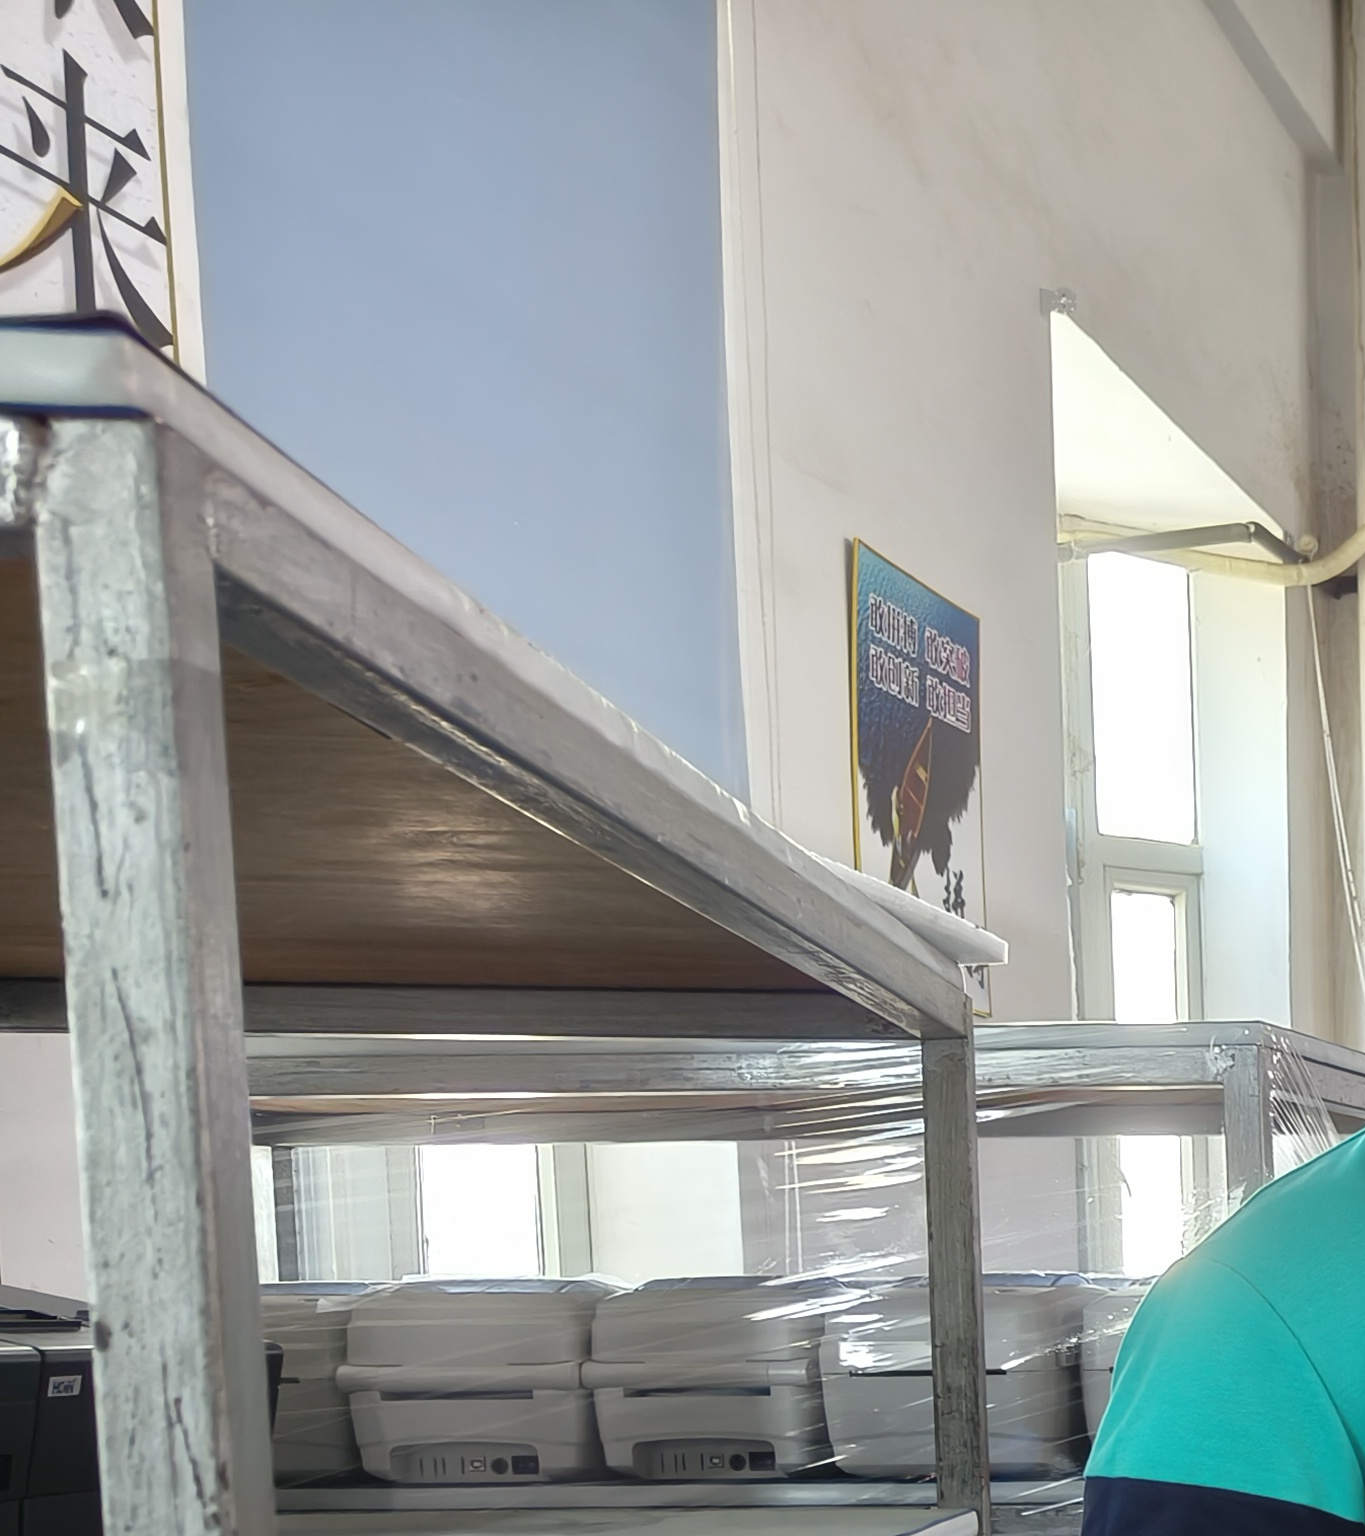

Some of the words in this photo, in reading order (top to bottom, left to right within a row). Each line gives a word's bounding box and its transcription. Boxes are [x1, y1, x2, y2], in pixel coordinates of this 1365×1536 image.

[869, 593, 918, 657] 敢拼搏
[925, 626, 970, 687] 敢突破
[869, 644, 919, 707] 敢创新
[926, 675, 971, 733] 敢担当
